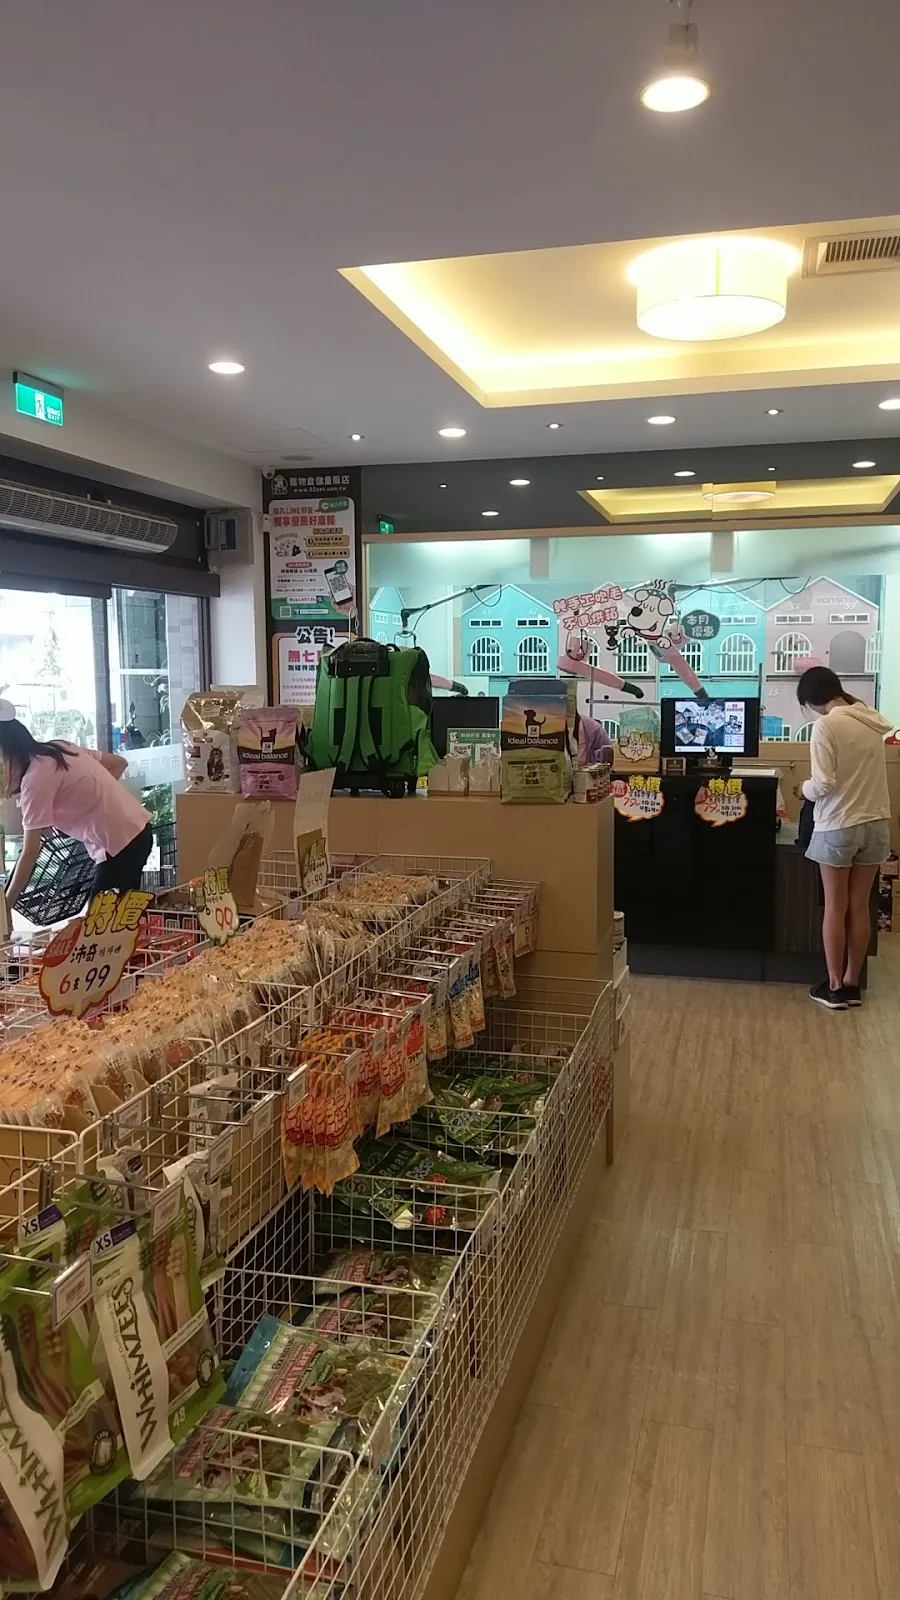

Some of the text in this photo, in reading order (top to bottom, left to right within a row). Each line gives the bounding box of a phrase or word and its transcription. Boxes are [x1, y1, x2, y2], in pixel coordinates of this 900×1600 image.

[553, 585, 623, 614] 純手工吹毛
[481, 608, 491, 616] S1
[528, 607, 538, 615] S2
[686, 614, 709, 626] 本月
[295, 626, 335, 645] 公告!
[691, 626, 714, 637] 優惠
[287, 650, 321, 663] 無七
[527, 737, 559, 745] balance
[261, 752, 289, 760] balance
[631, 749, 643, 758] 79
[628, 775, 662, 793] 特價
[708, 778, 743, 795] 特價
[623, 797, 637, 807] 79
[703, 802, 717, 813] 79
[204, 867, 230, 895] 特價
[84, 890, 155, 936] 特價
[70, 943, 98, 964] 沛奇
[59, 972, 71, 995] 6
[85, 964, 111, 992] 99
[22, 1219, 38, 1237] XS
[95, 1234, 111, 1253] XS
[111, 1276, 159, 1454] WHIMZEES
[172, 1405, 187, 1428] 48
